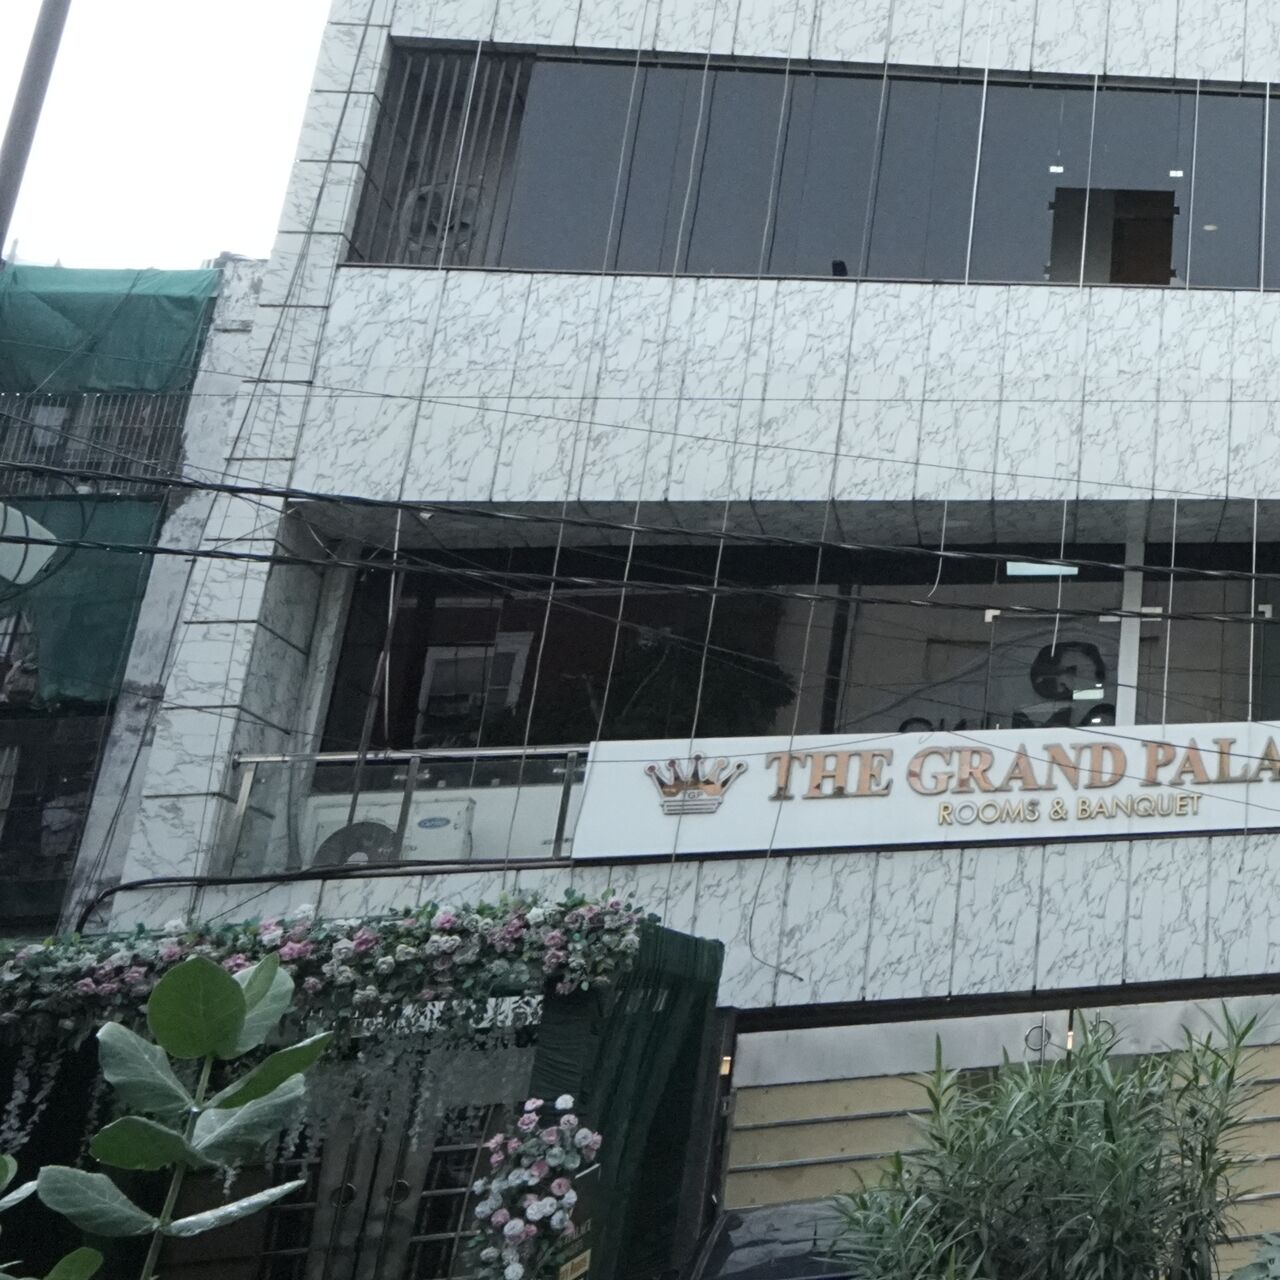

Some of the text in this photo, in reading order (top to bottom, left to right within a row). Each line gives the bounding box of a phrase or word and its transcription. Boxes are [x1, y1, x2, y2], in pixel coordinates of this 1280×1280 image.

[765, 747, 893, 801] THE
[906, 741, 1128, 796] GRAND
[938, 791, 1202, 826] ROOMS & BANQUET
